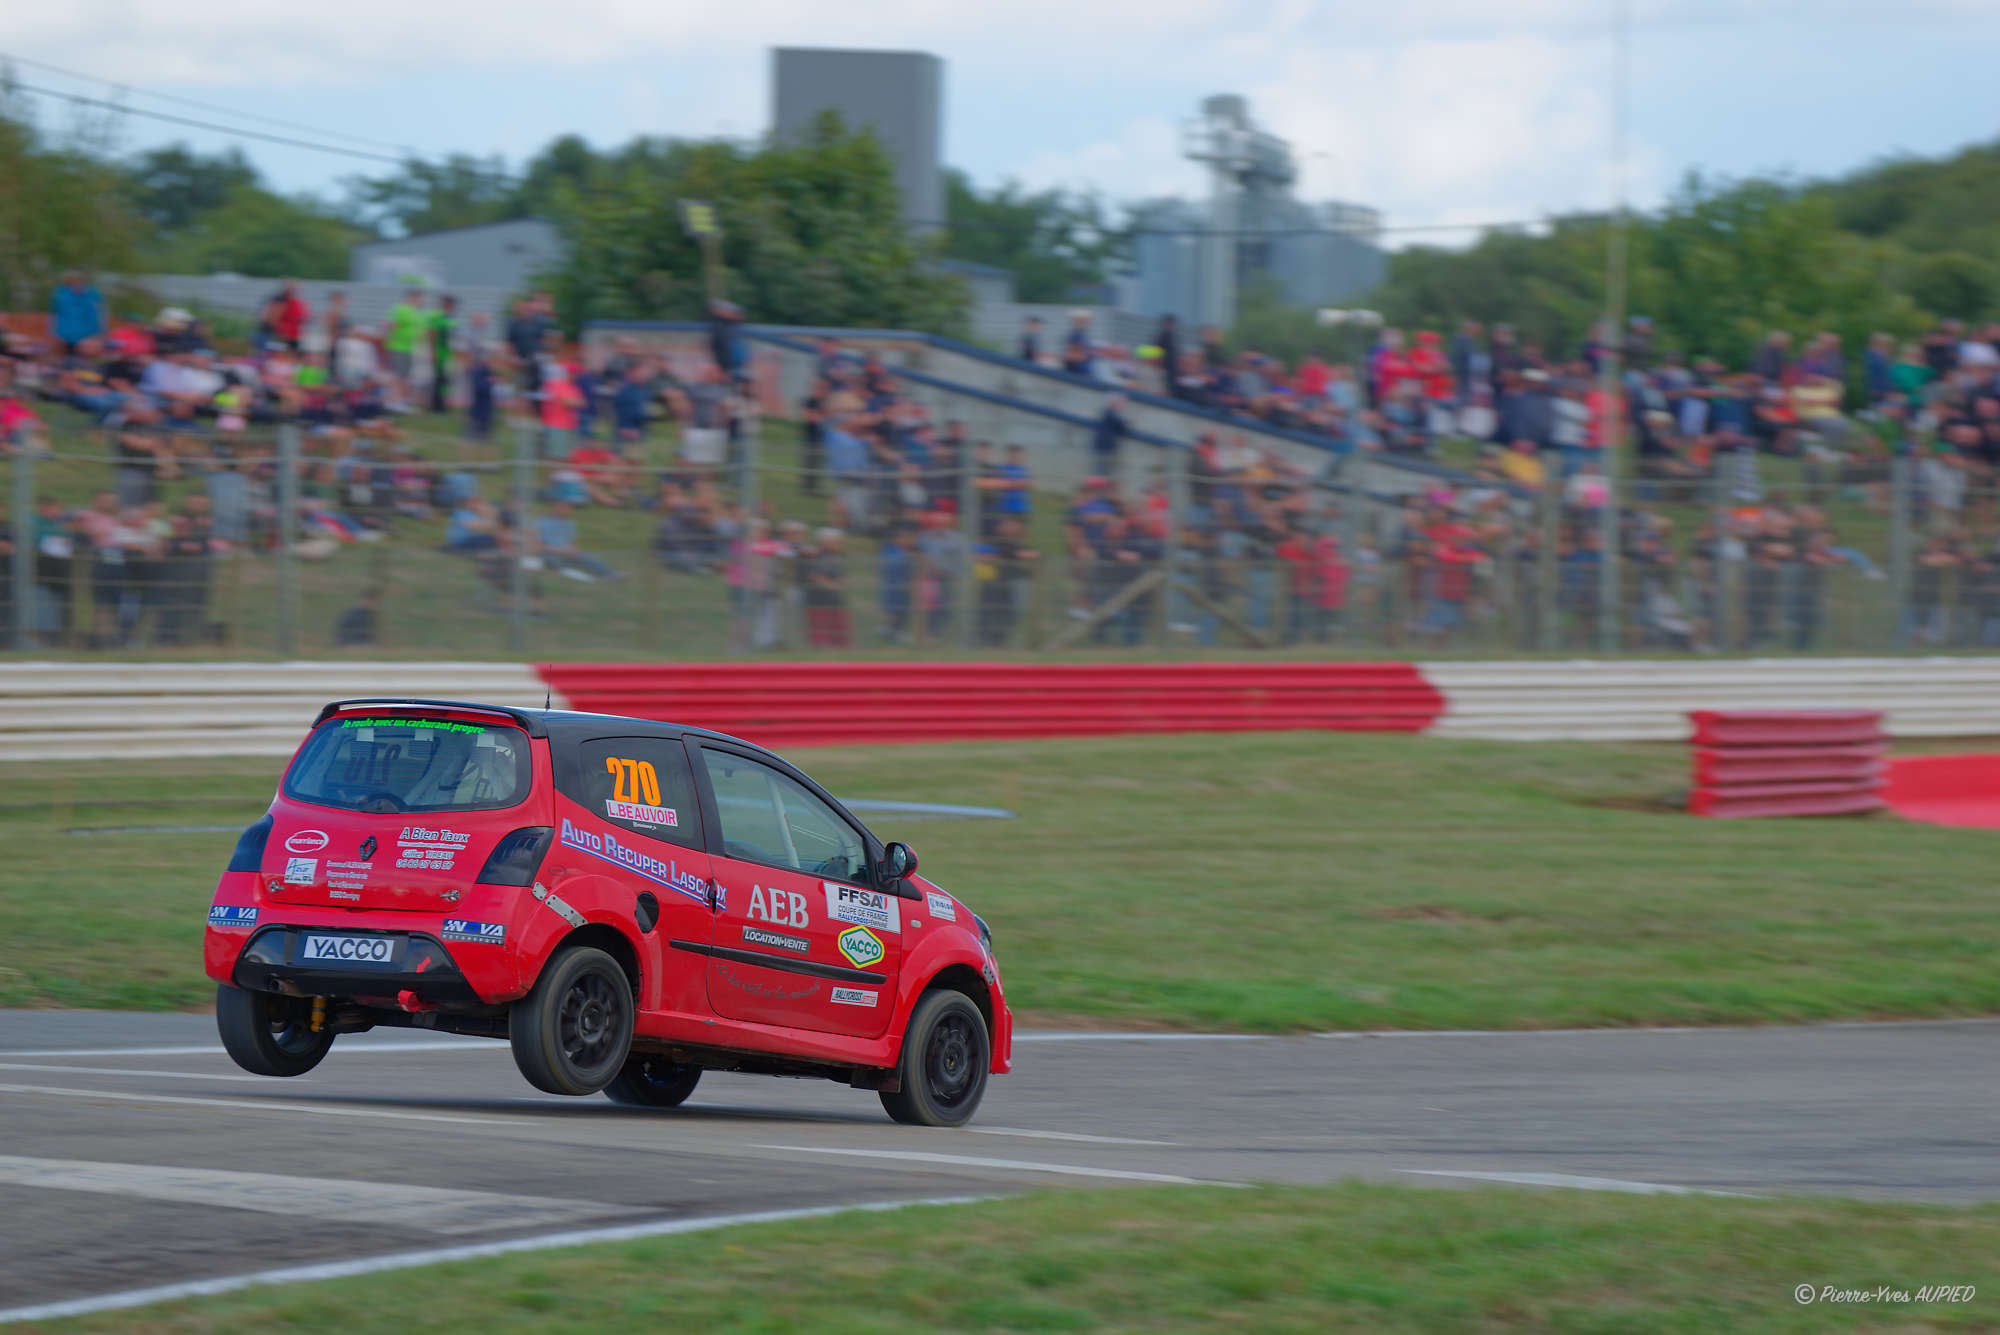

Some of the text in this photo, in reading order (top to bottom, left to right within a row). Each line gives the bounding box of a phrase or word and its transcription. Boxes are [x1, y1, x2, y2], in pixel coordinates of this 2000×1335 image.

[352, 718, 373, 728] roule
[373, 719, 393, 728] avec
[393, 719, 406, 728] un
[407, 718, 453, 730] carburant
[451, 724, 486, 735] propre
[605, 757, 662, 806] 270
[607, 802, 677, 825] L.BEAUVOIR
[399, 826, 471, 843] A Bien Taux
[746, 883, 809, 929] AEB
[838, 887, 884, 910] FFSA
[838, 904, 857, 914] COUPE
[857, 908, 866, 917] DE
[313, 938, 389, 960] YACCO
[845, 936, 879, 957] YACCO
